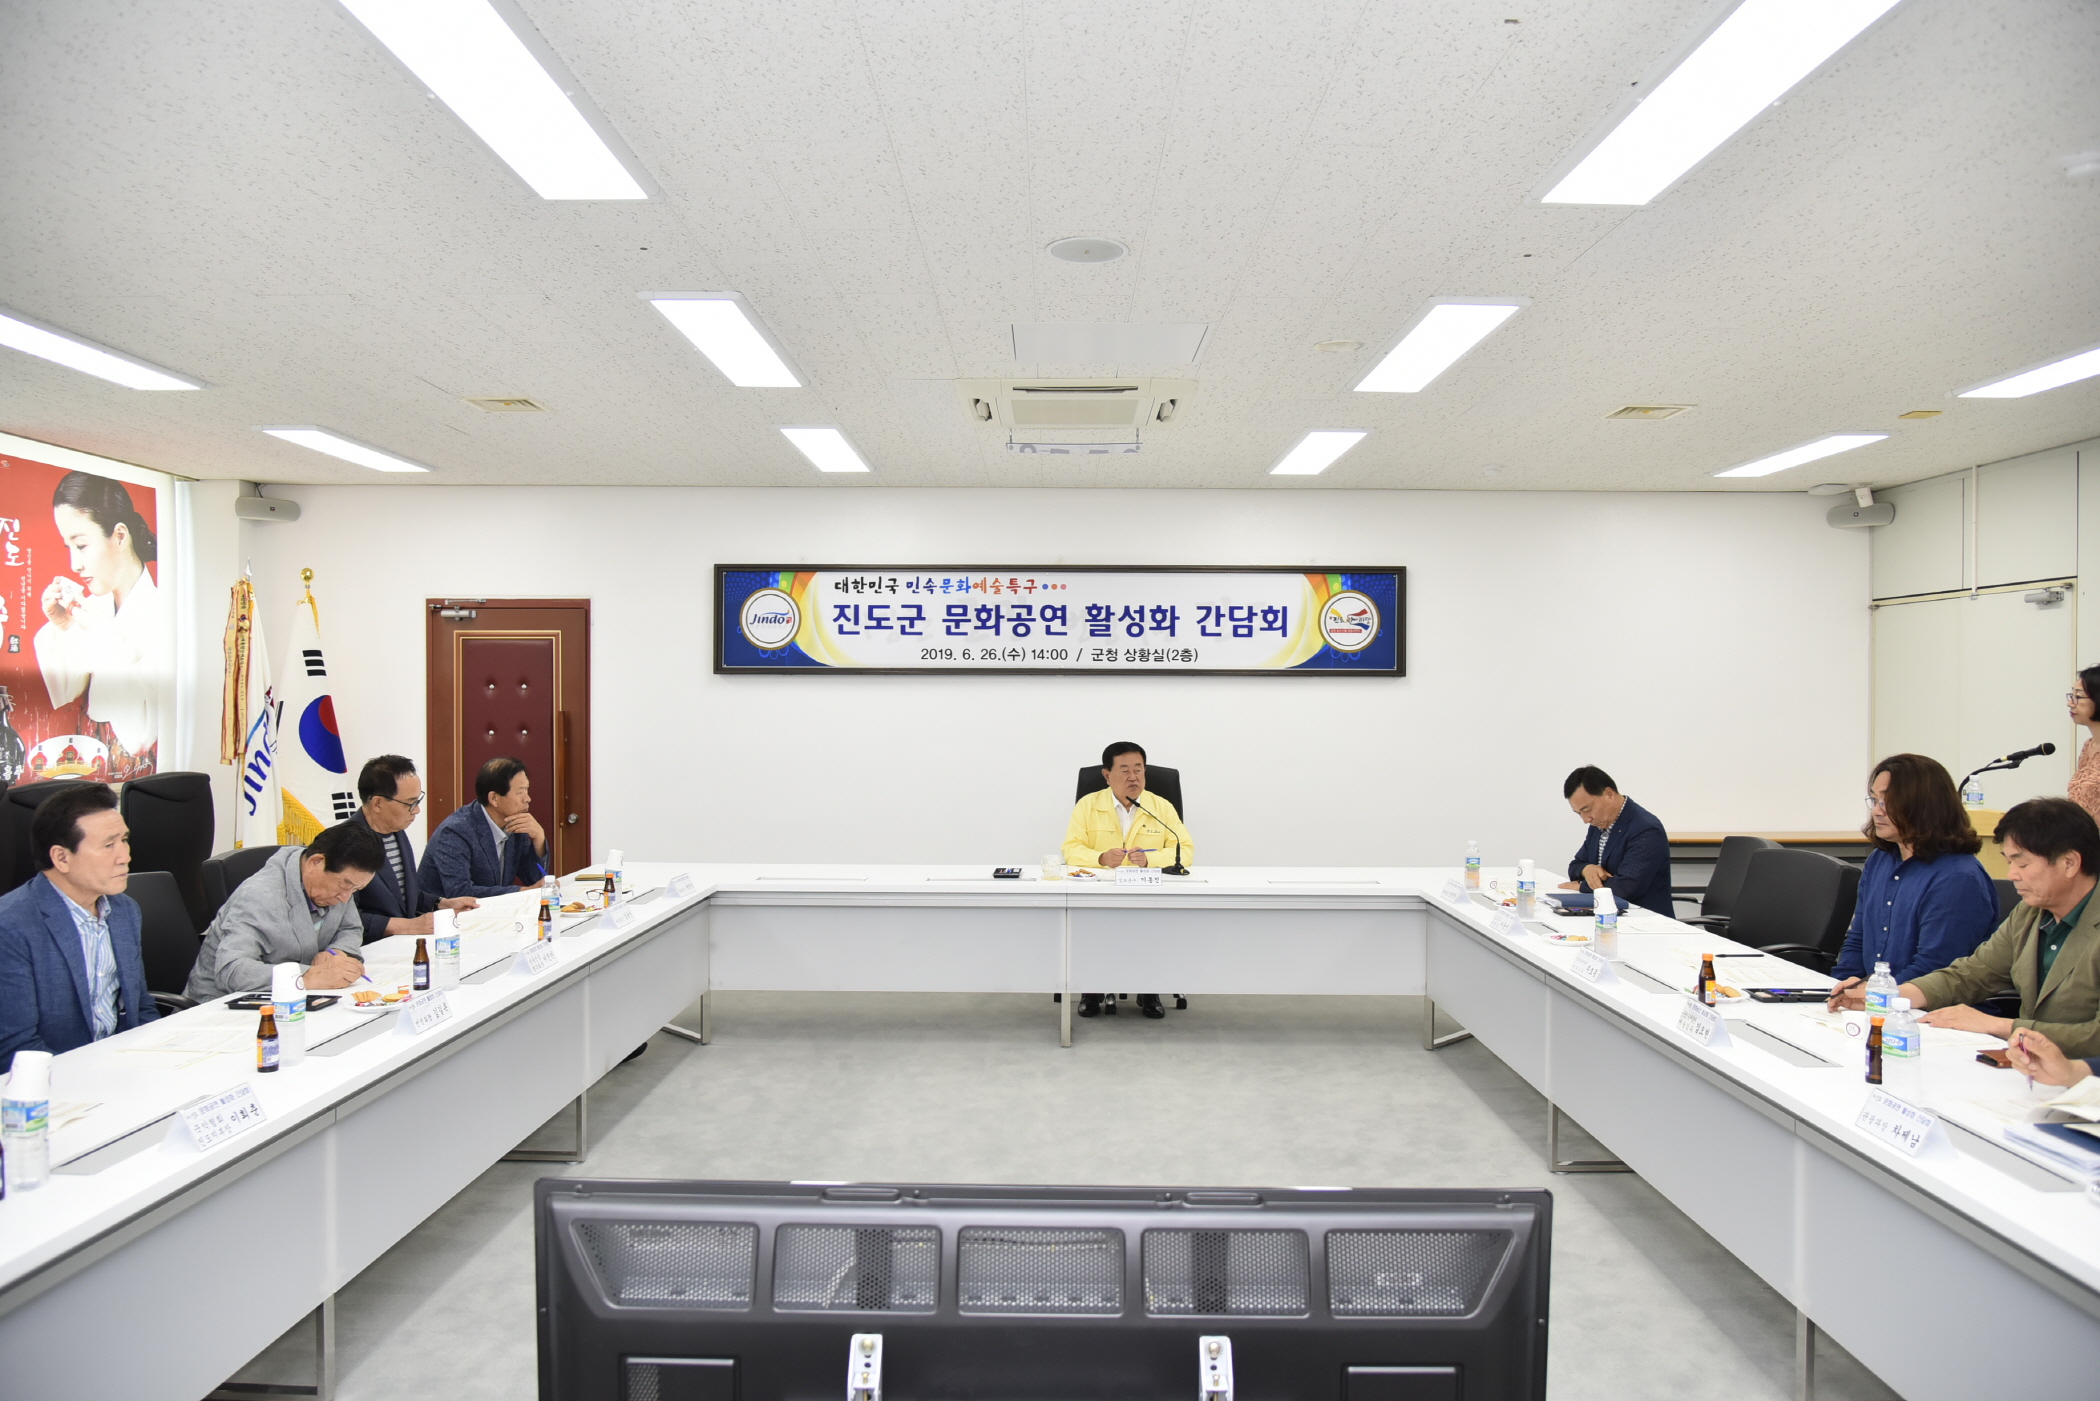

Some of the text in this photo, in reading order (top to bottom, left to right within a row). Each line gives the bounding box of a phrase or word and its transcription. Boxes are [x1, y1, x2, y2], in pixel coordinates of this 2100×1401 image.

[835, 576, 1038, 595] 대한민국 민속문화예술특구
[749, 613, 785, 625] Jindo
[833, 603, 1288, 638] 진도군 문화공연 활성화 간담회
[921, 648, 957, 661] 2019.
[962, 648, 975, 661] 6.
[981, 647, 1026, 662] 26.(수)
[1031, 648, 1068, 661] 14:00
[1090, 648, 1118, 663] 군청
[1123, 647, 1199, 663] 상황실(2층)
